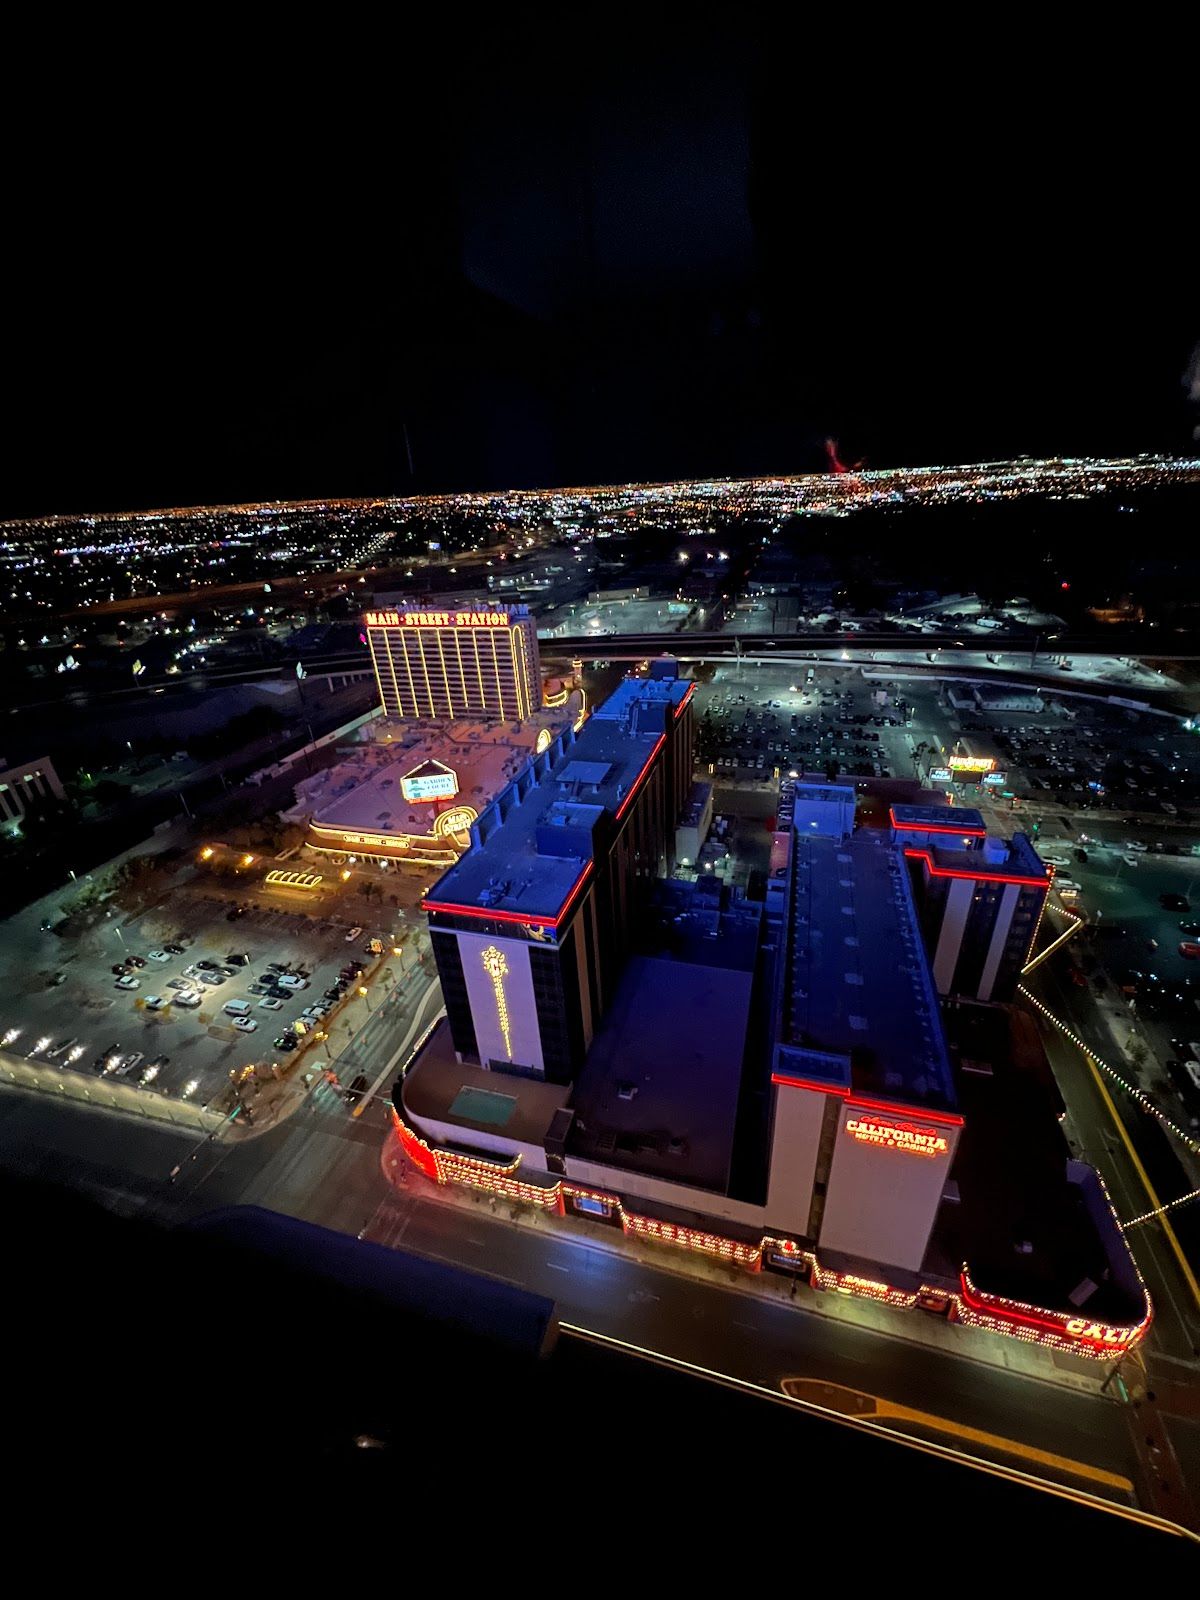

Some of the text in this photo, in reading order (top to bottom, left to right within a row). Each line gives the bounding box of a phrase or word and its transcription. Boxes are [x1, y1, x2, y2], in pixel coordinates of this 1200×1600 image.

[366, 613, 508, 626] MAIN STREET STATION
[846, 1120, 947, 1151] CALIFORNIA
[855, 1133, 884, 1144] HOTEL
[896, 1140, 935, 1154] CASINO
